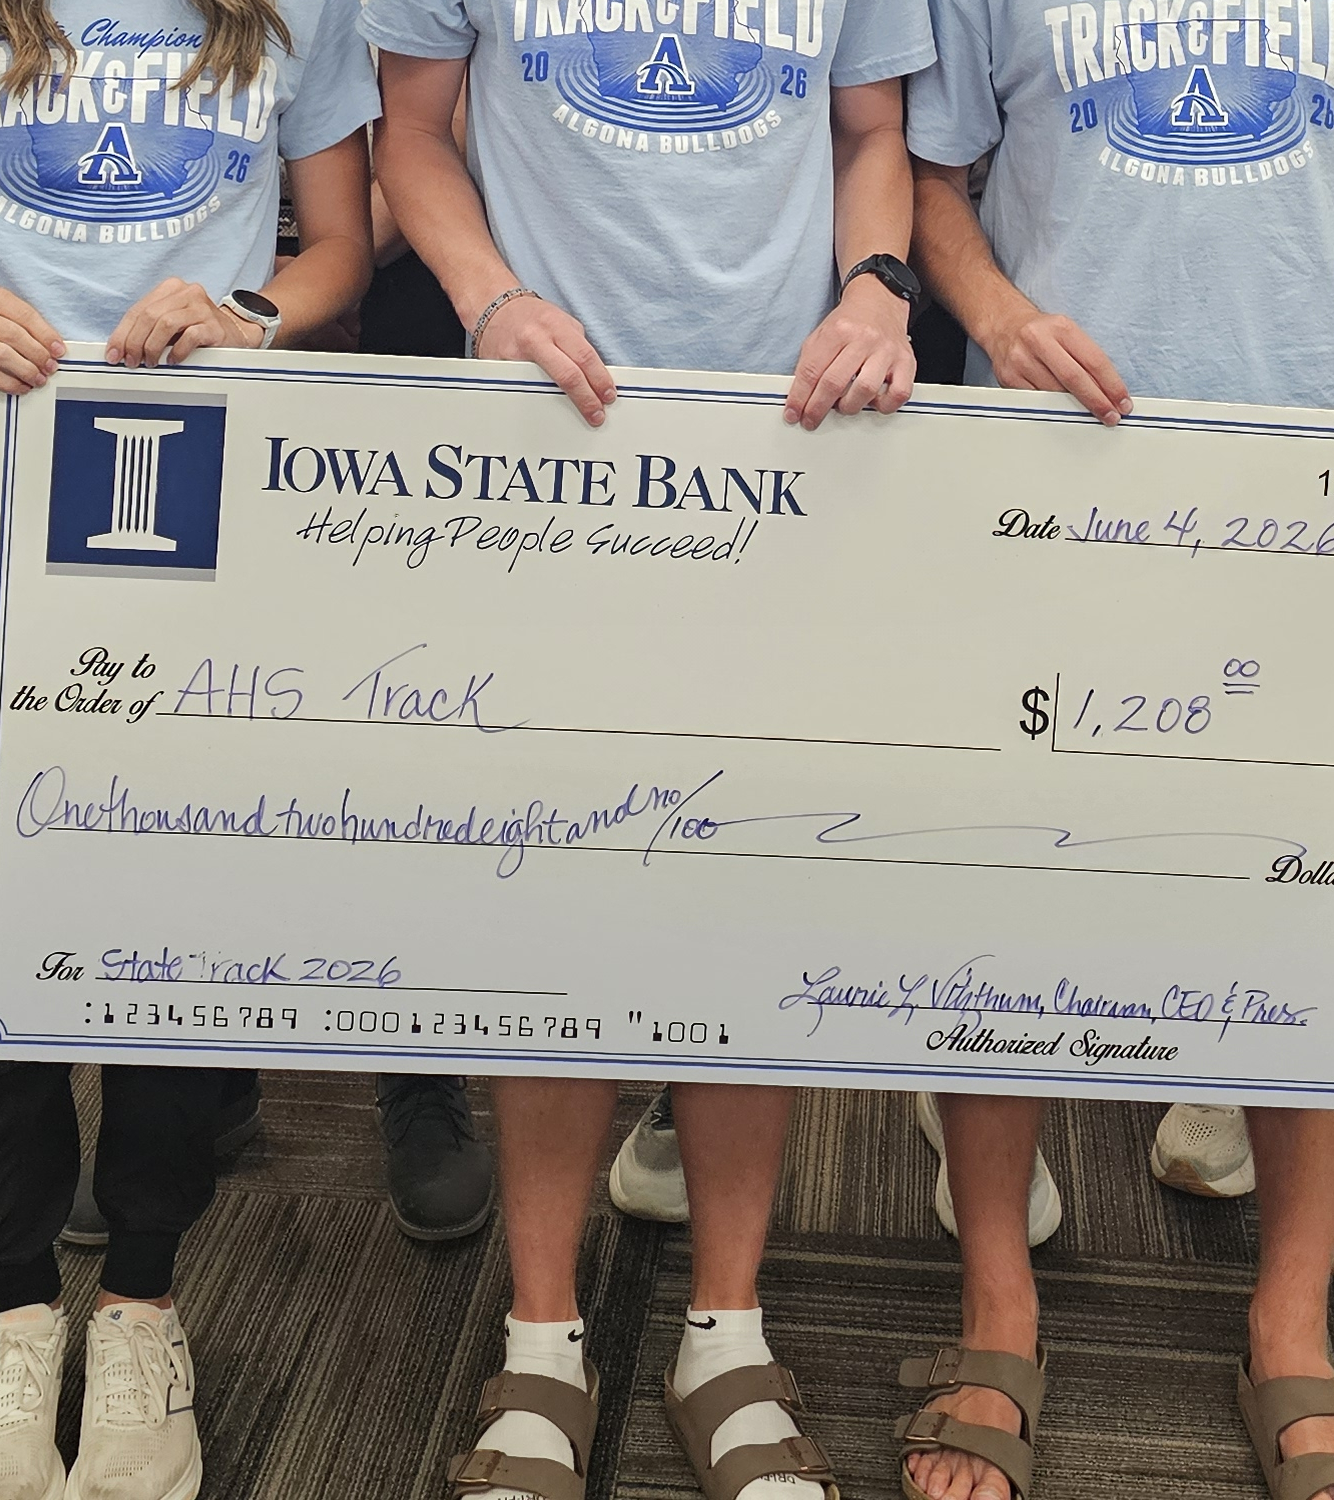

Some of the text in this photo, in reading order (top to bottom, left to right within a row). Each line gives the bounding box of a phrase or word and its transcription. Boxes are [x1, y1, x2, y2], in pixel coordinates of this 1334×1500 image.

[81, 17, 203, 59] Champion
[521, 51, 808, 100] 20 26
[552, 104, 783, 155] ALGONA BULLDOGS
[1069, 94, 1334, 134] 20 26
[224, 150, 251, 184] 26
[1098, 140, 1314, 188] ALGONA BULLDOGS
[99, 194, 222, 245] BULLDOGS
[262, 437, 807, 517] IOWA STATE BANK
[297, 510, 443, 570] Helping
[441, 514, 574, 574] People
[992, 508, 1061, 541] Date
[1067, 506, 1151, 546] June
[70, 645, 157, 685] Pay to
[10, 686, 159, 726] the Order of
[175, 658, 304, 722] AHS
[1019, 686, 1050, 742] $
[35, 951, 85, 982] For
[99, 946, 183, 983] State
[298, 956, 402, 988] 2026
[1161, 984, 1215, 1022] CEO
[926, 1023, 1180, 1066] Authorized Signature
